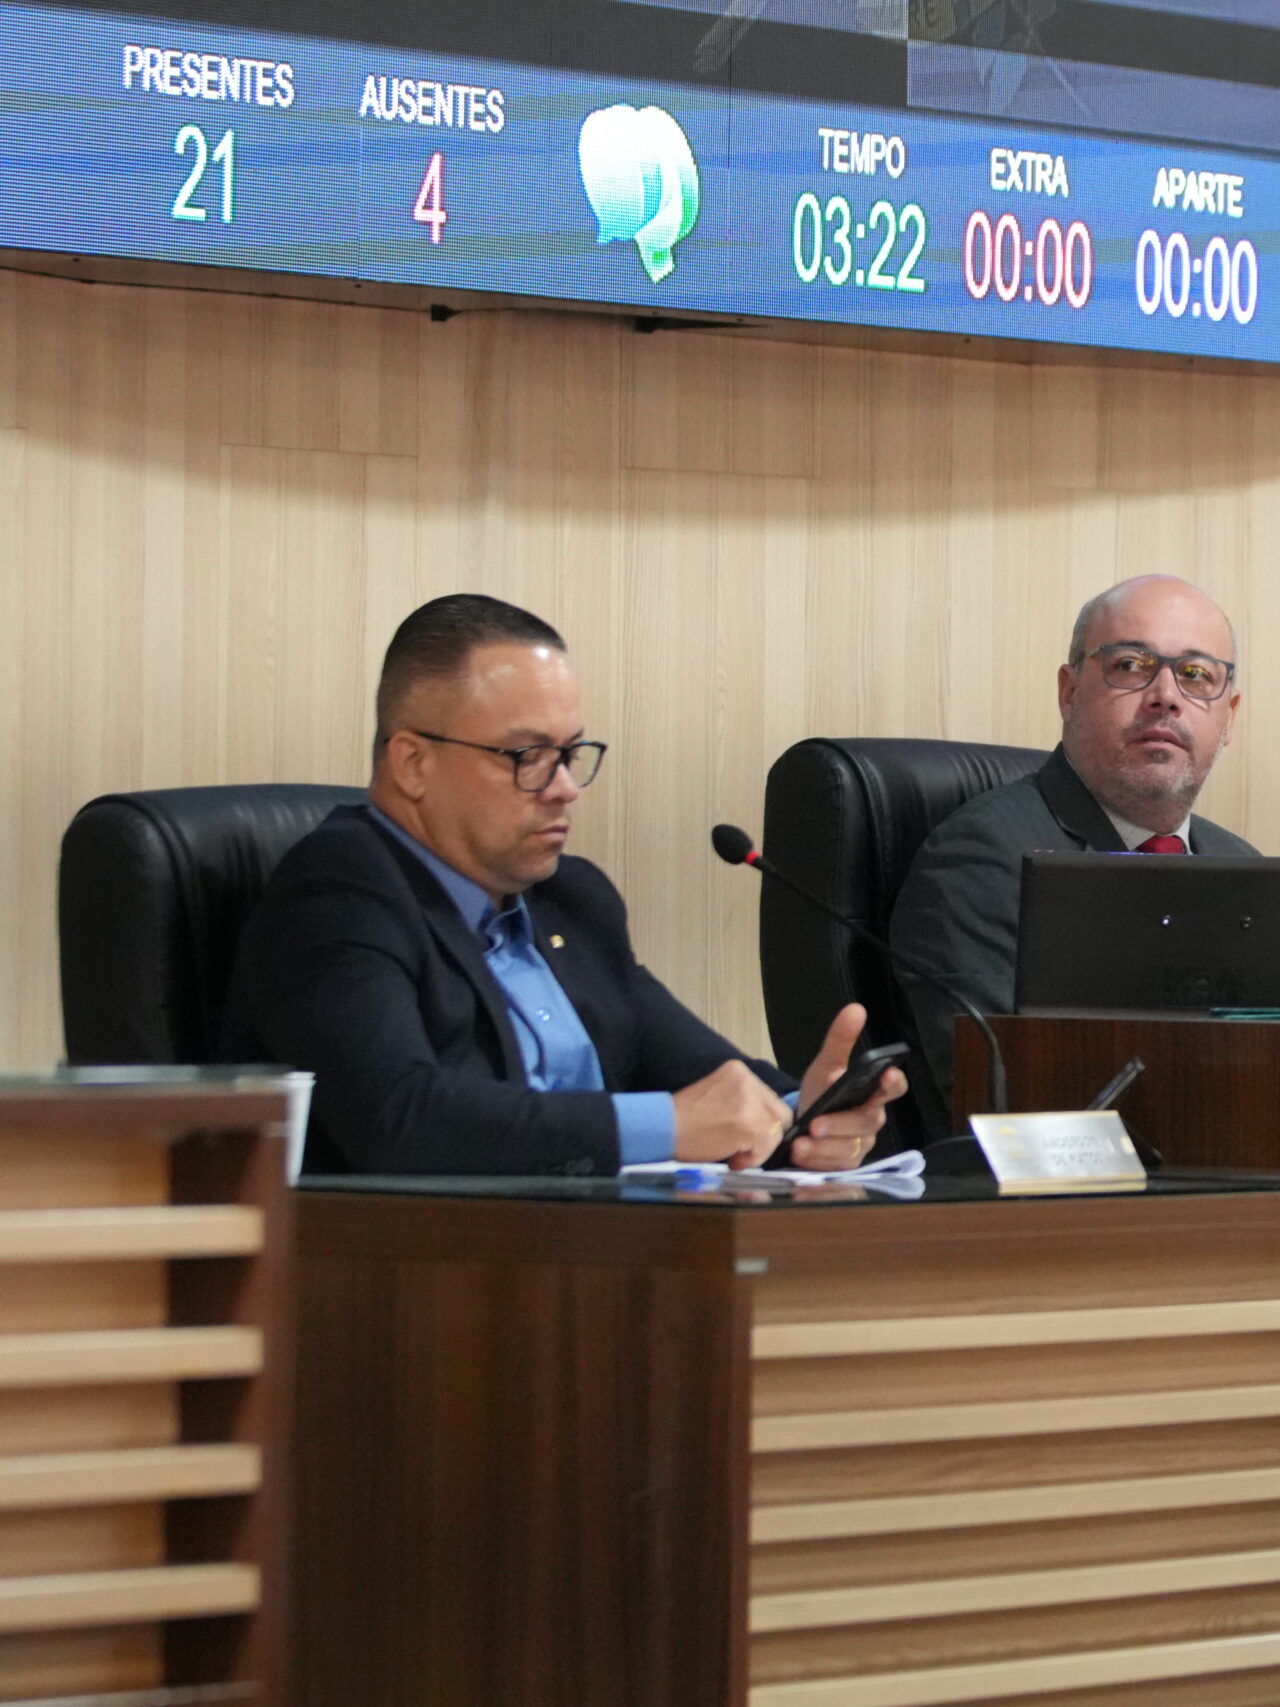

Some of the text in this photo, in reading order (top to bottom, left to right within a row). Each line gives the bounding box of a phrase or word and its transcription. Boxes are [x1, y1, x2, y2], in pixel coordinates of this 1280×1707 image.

[123, 44, 295, 108] PRESENTES
[359, 75, 505, 133] AUSENTES
[172, 124, 237, 224] 21
[817, 127, 906, 179] TEMPO
[990, 147, 1070, 198] EXTRA
[1152, 167, 1244, 218] APARTE
[412, 151, 448, 245] 4
[793, 192, 927, 293] 03:22
[963, 209, 1093, 309] 00:00
[1134, 228, 1259, 325] 00:00
